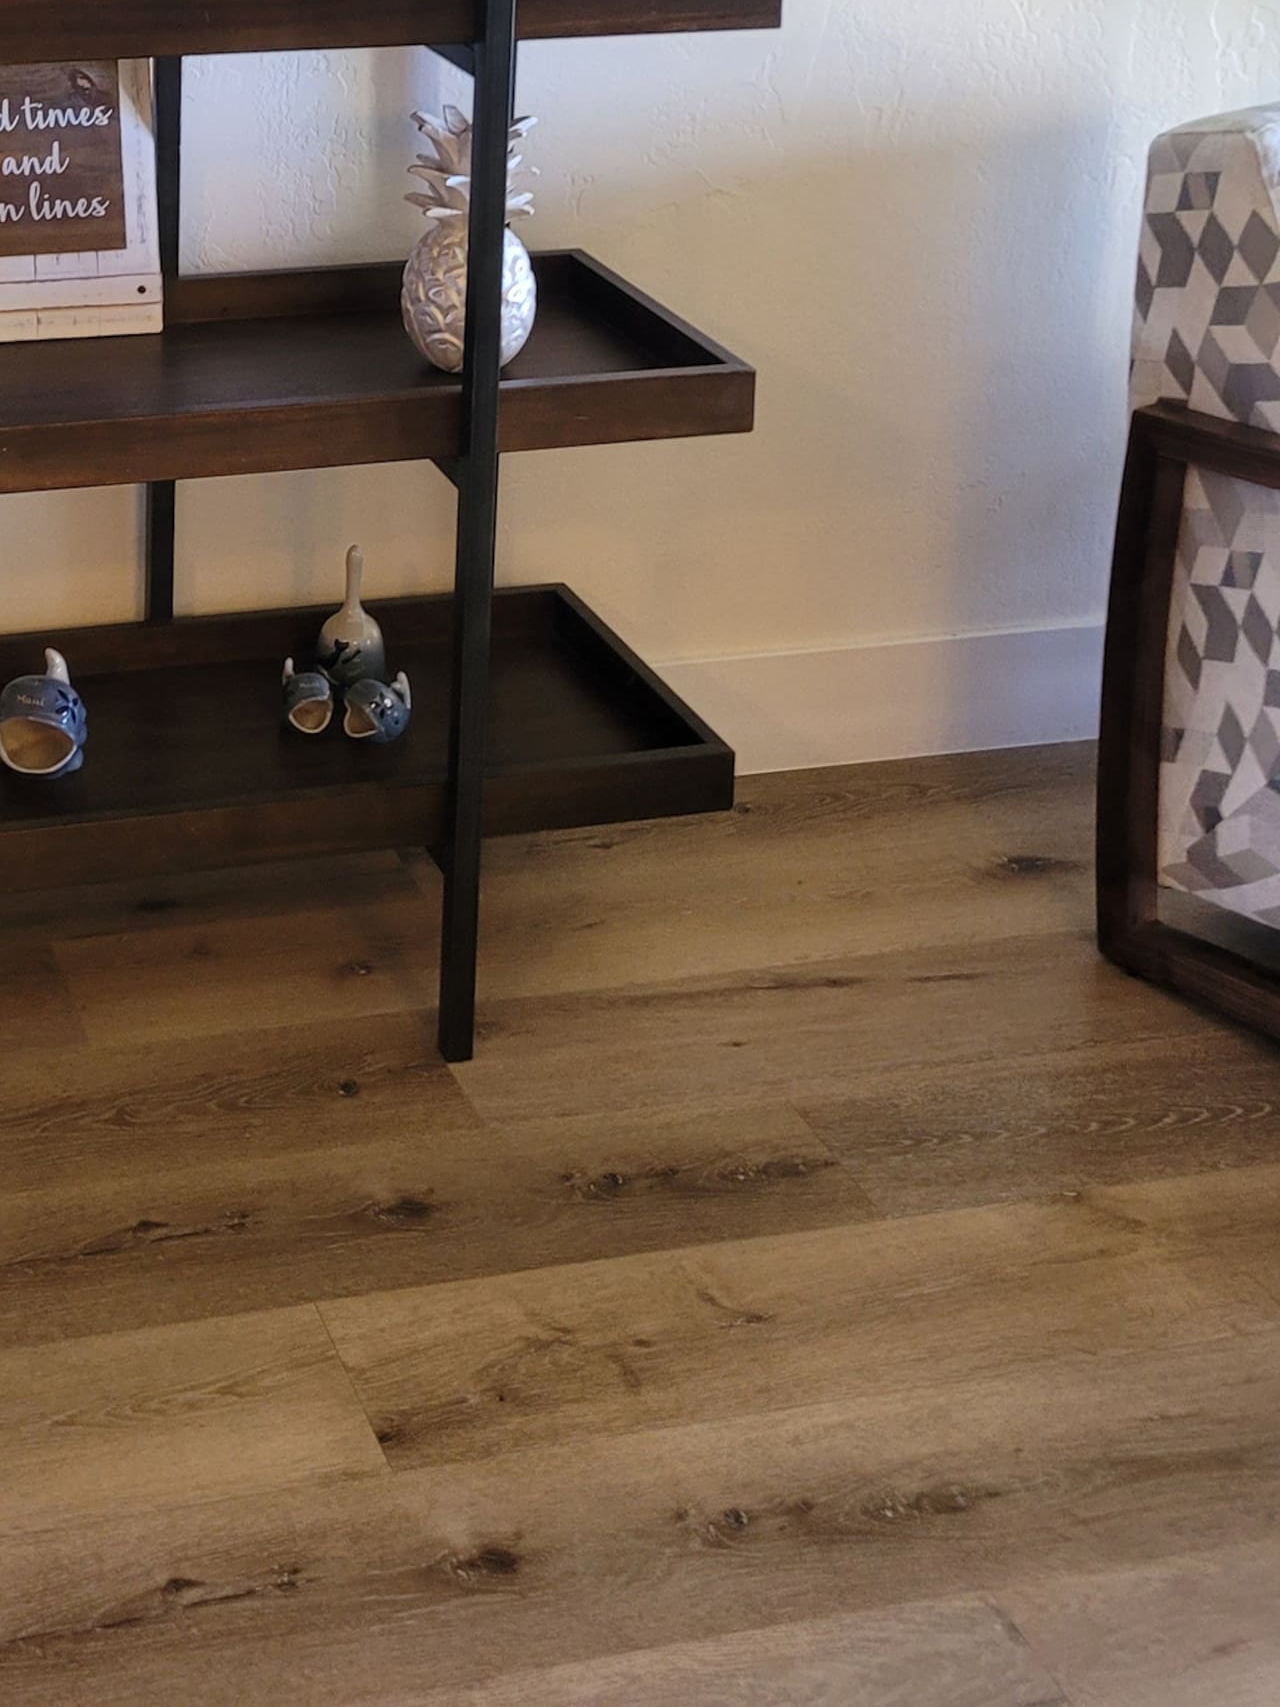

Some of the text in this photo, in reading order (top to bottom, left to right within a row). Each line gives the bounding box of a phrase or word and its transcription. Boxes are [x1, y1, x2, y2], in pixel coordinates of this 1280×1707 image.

[20, 96, 113, 131] times
[1, 141, 70, 176] and
[28, 181, 110, 221] lines
